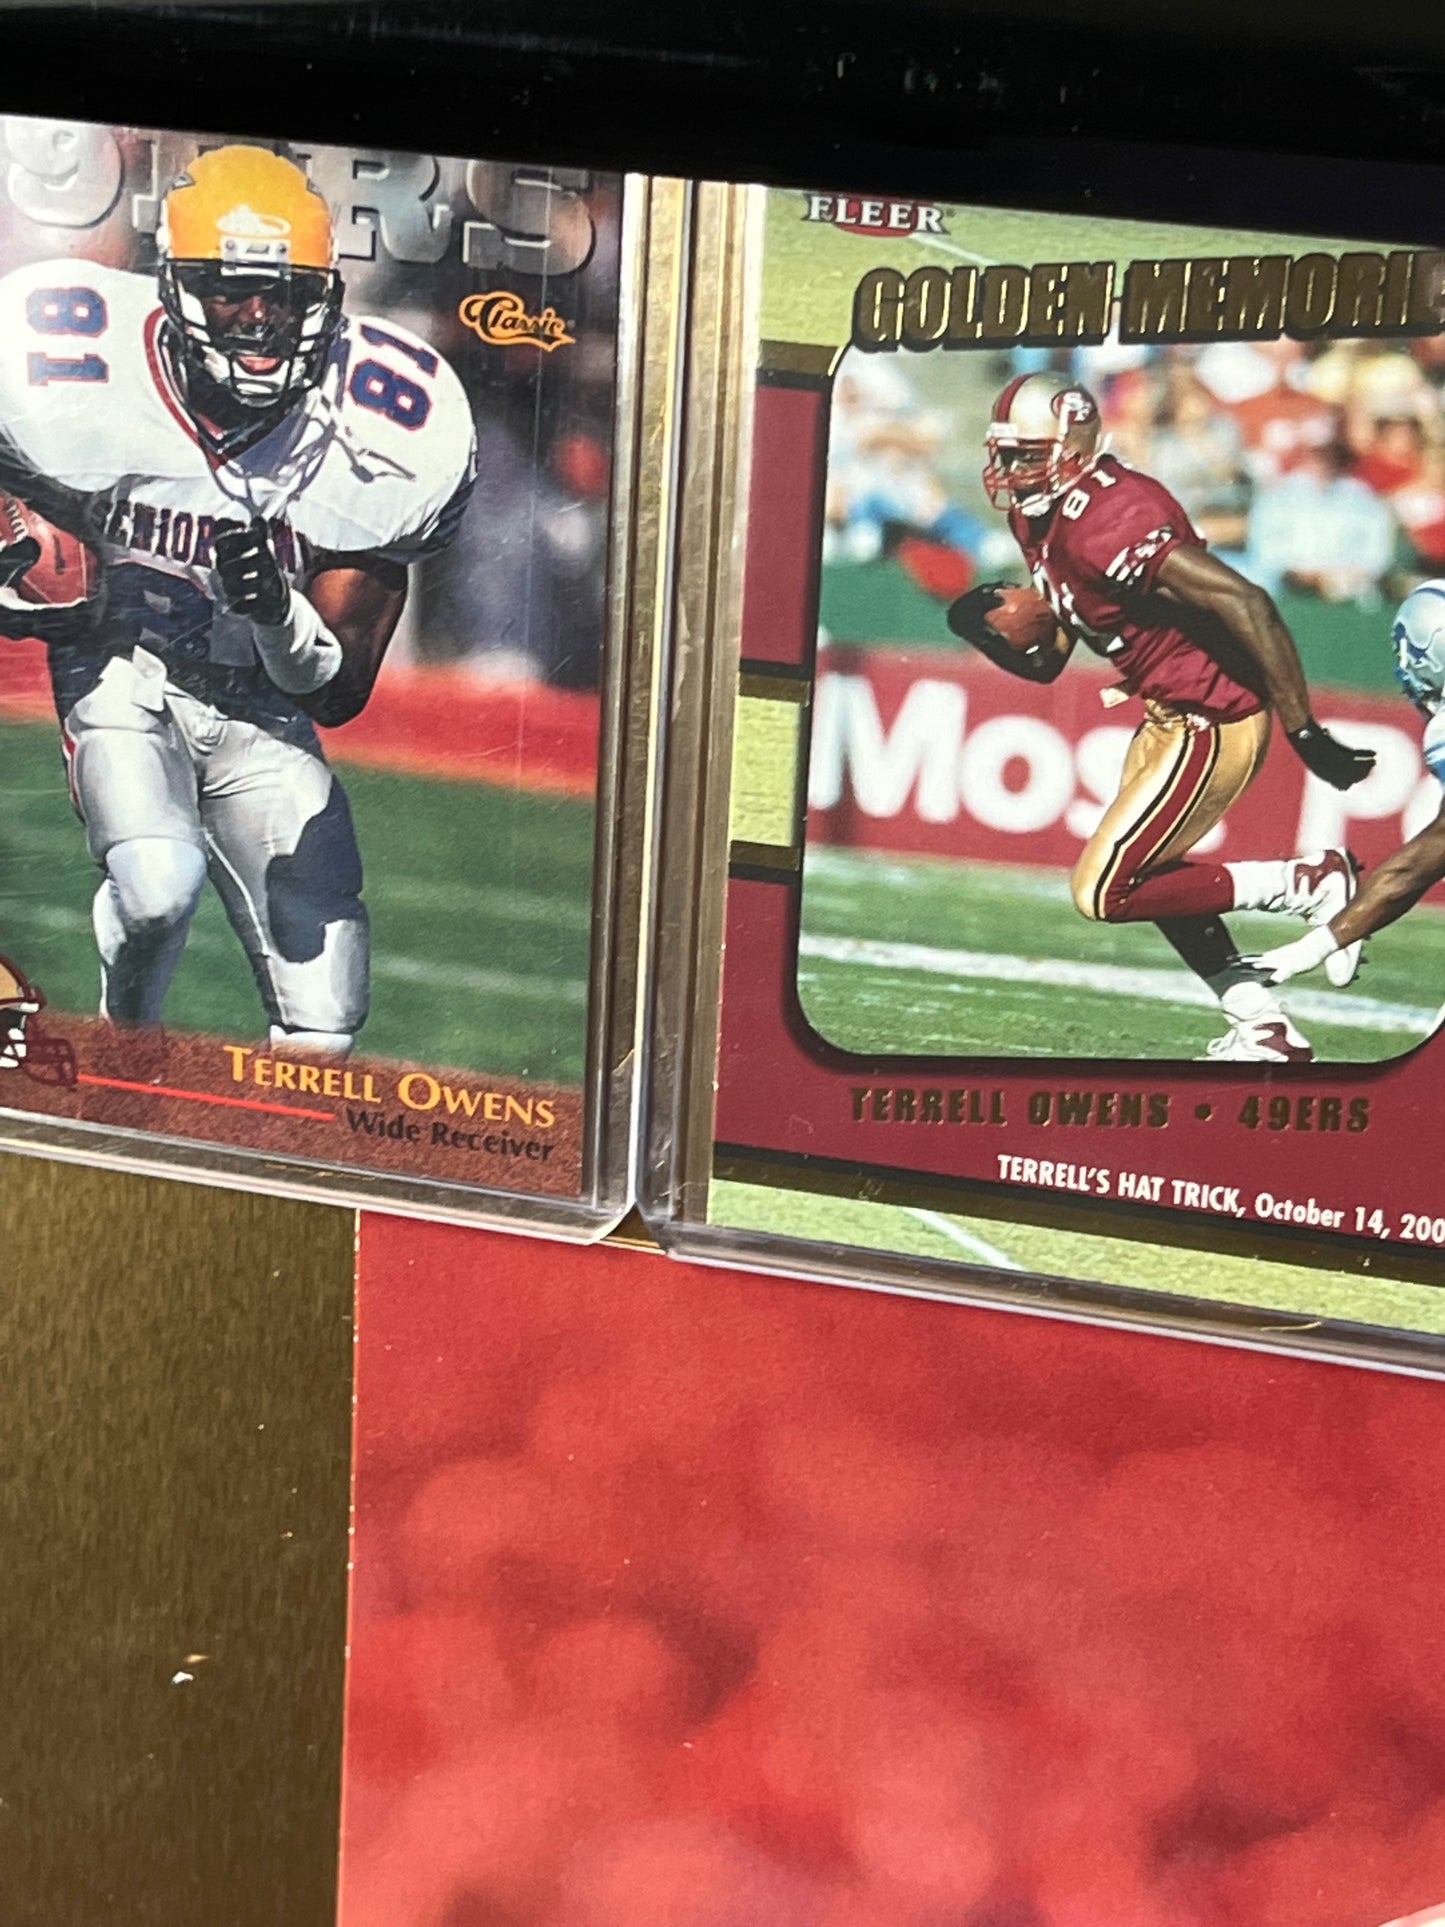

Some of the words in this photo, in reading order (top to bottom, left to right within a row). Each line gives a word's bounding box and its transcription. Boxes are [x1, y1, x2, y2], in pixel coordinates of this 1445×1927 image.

[807, 196, 944, 232] FLEER
[458, 292, 576, 351] Classic
[852, 261, 1115, 353] GOLDEN
[222, 1044, 383, 1104] TERRELL
[397, 1072, 557, 1130] OWENS
[851, 1088, 1008, 1128] TERRELL
[1028, 1091, 1172, 1129] OWENS
[1237, 1095, 1371, 1133] 49ERS
[344, 1107, 422, 1143] Wide
[430, 1121, 557, 1162] Receiver
[997, 1154, 1111, 1195] TERRELL'S
[1117, 1171, 1166, 1202] HAT
[1171, 1179, 1247, 1218] TRICK,
[1254, 1192, 1346, 1229] October
[1355, 1206, 1391, 1239] 14,
